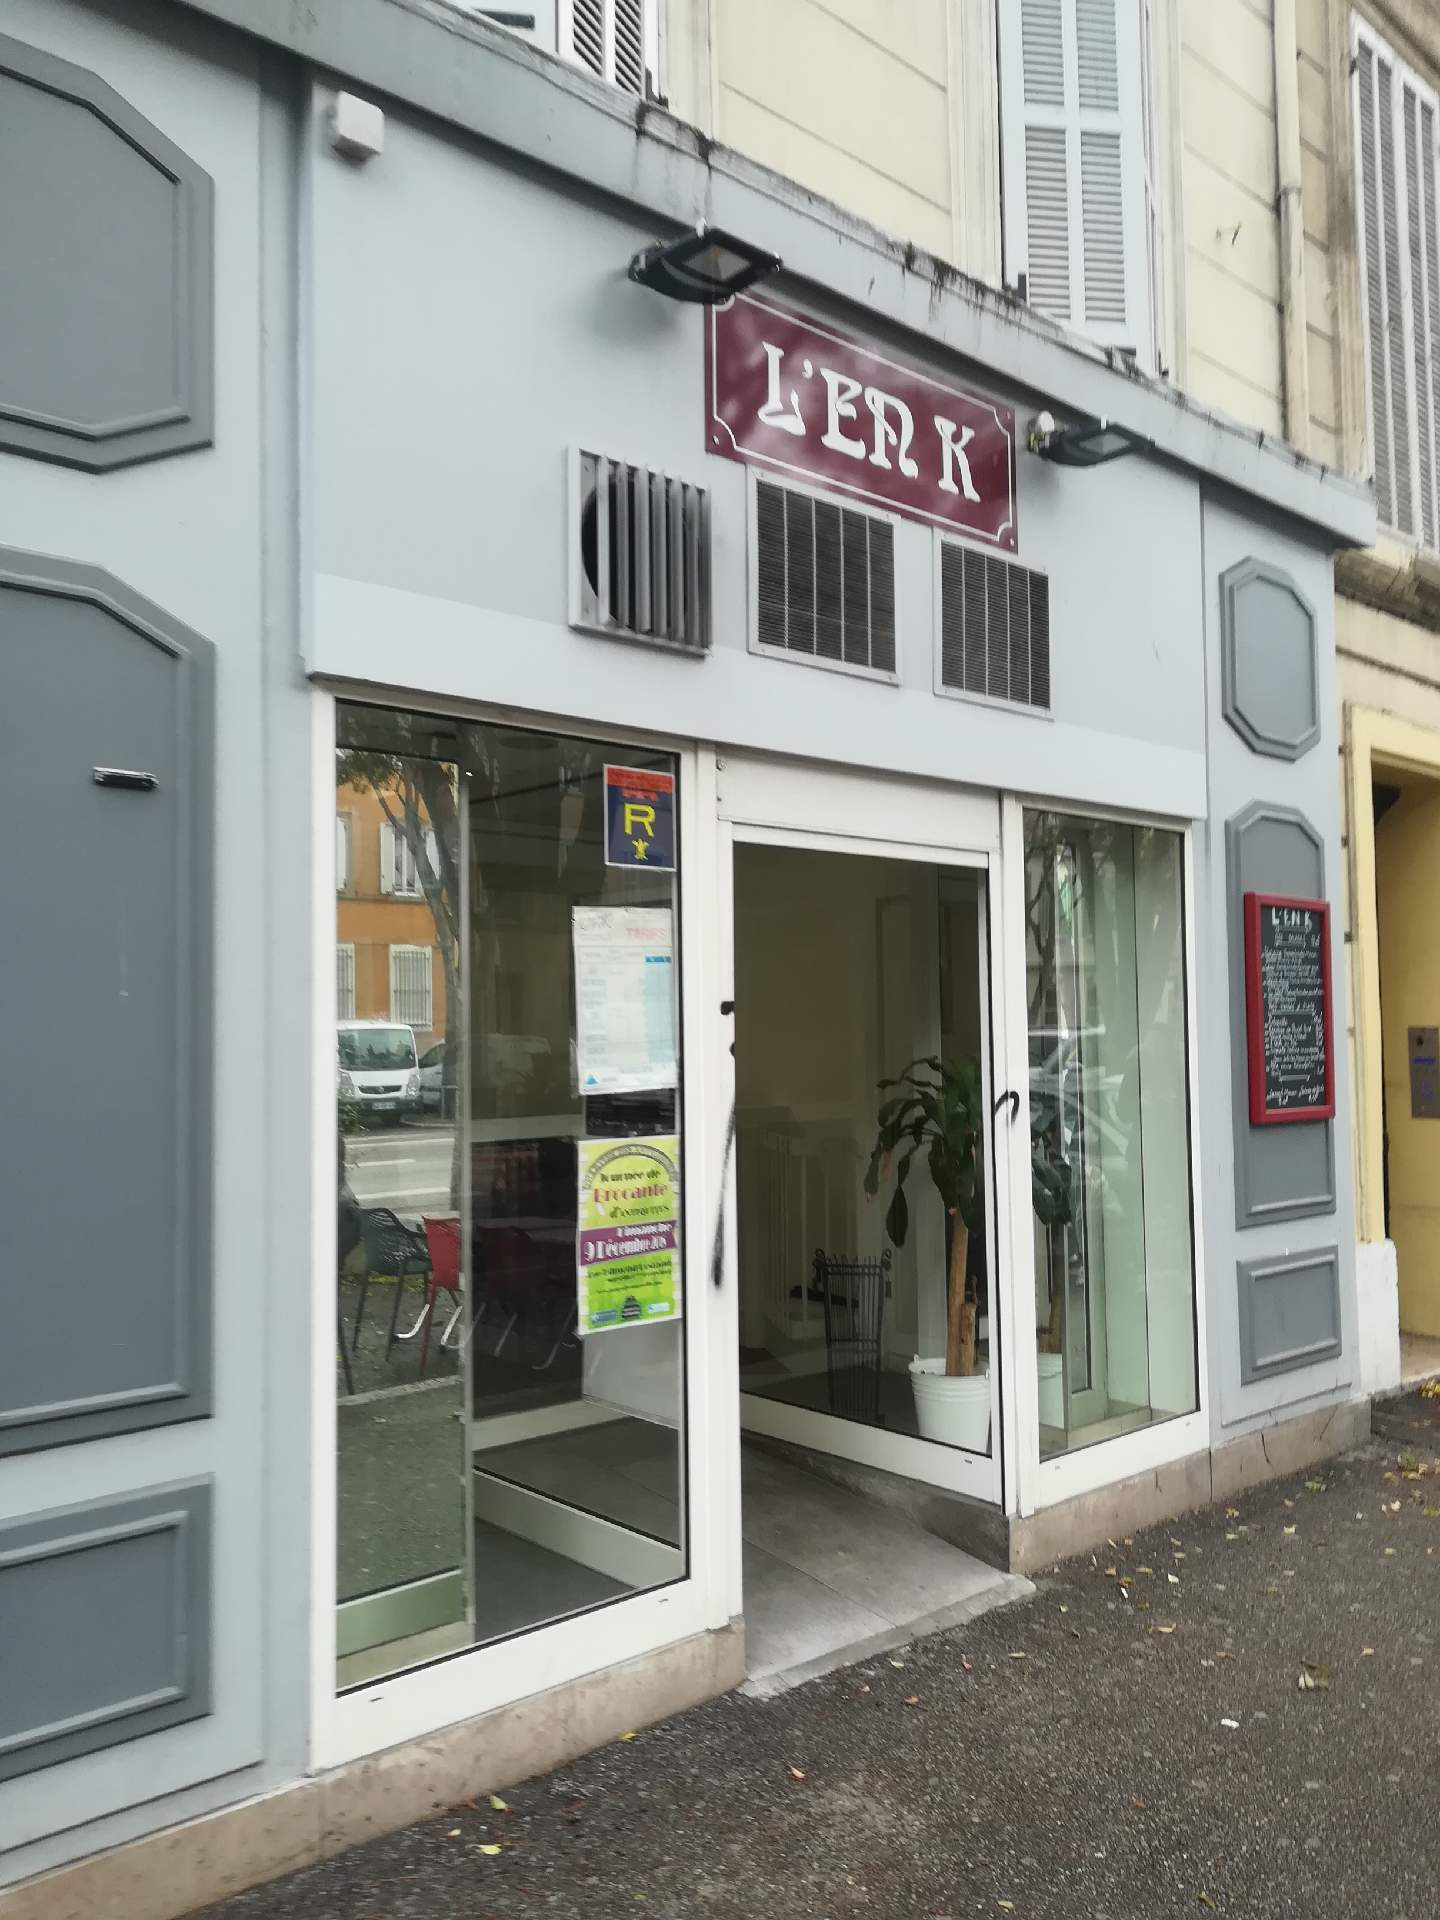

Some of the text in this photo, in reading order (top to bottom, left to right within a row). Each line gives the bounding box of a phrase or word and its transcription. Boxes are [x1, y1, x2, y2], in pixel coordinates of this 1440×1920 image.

[757, 341, 981, 503] L'EN K
[624, 803, 656, 837] R
